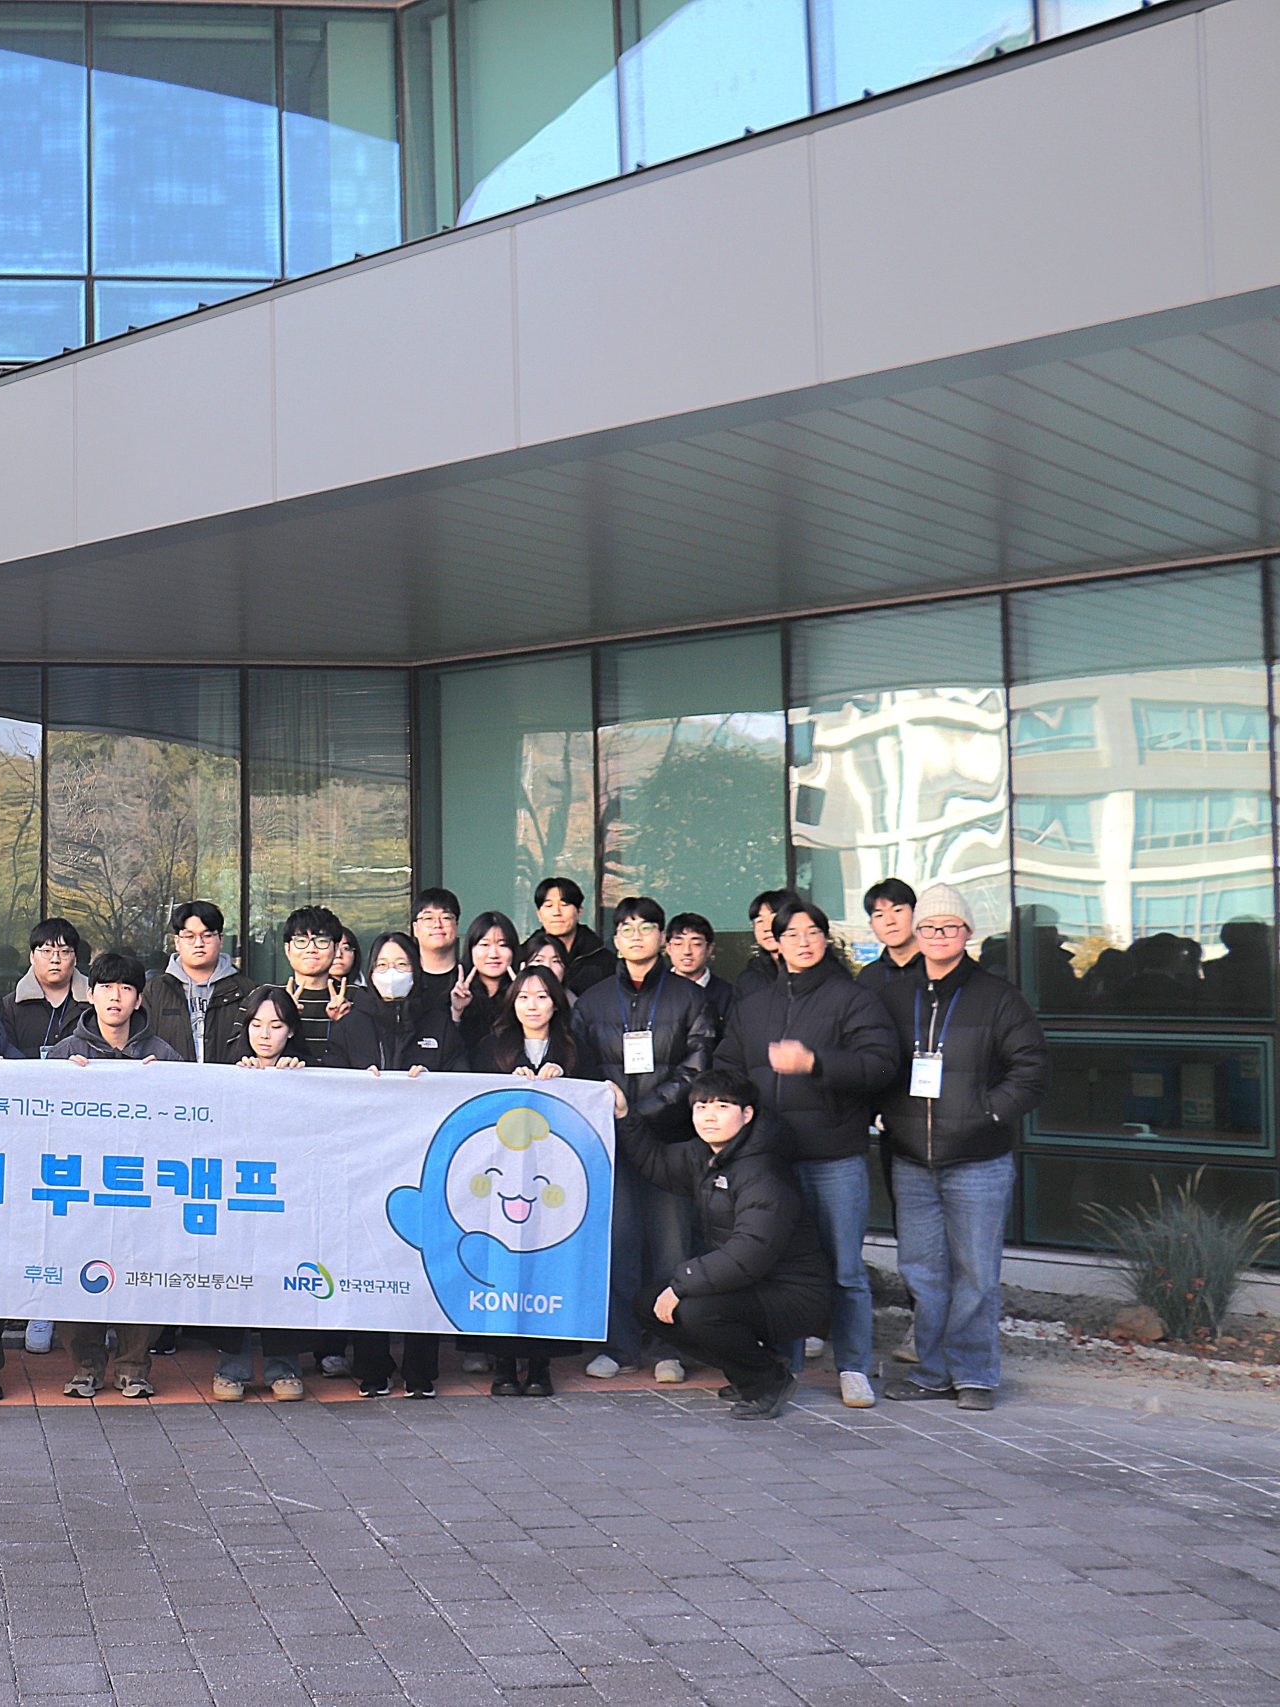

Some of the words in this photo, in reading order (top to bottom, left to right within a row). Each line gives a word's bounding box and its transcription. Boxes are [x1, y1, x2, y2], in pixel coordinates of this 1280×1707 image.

[61, 1102, 151, 1119] 2026.2.2.
[175, 1106, 213, 1122] 2.10.
[32, 1154, 284, 1235] 부트캠프
[24, 1265, 62, 1284] 후원
[125, 1272, 253, 1290] 과학기술정보통신부
[284, 1277, 323, 1291] NRF
[340, 1279, 410, 1294] 한국연구재단
[470, 1290, 563, 1314] KONICOF
